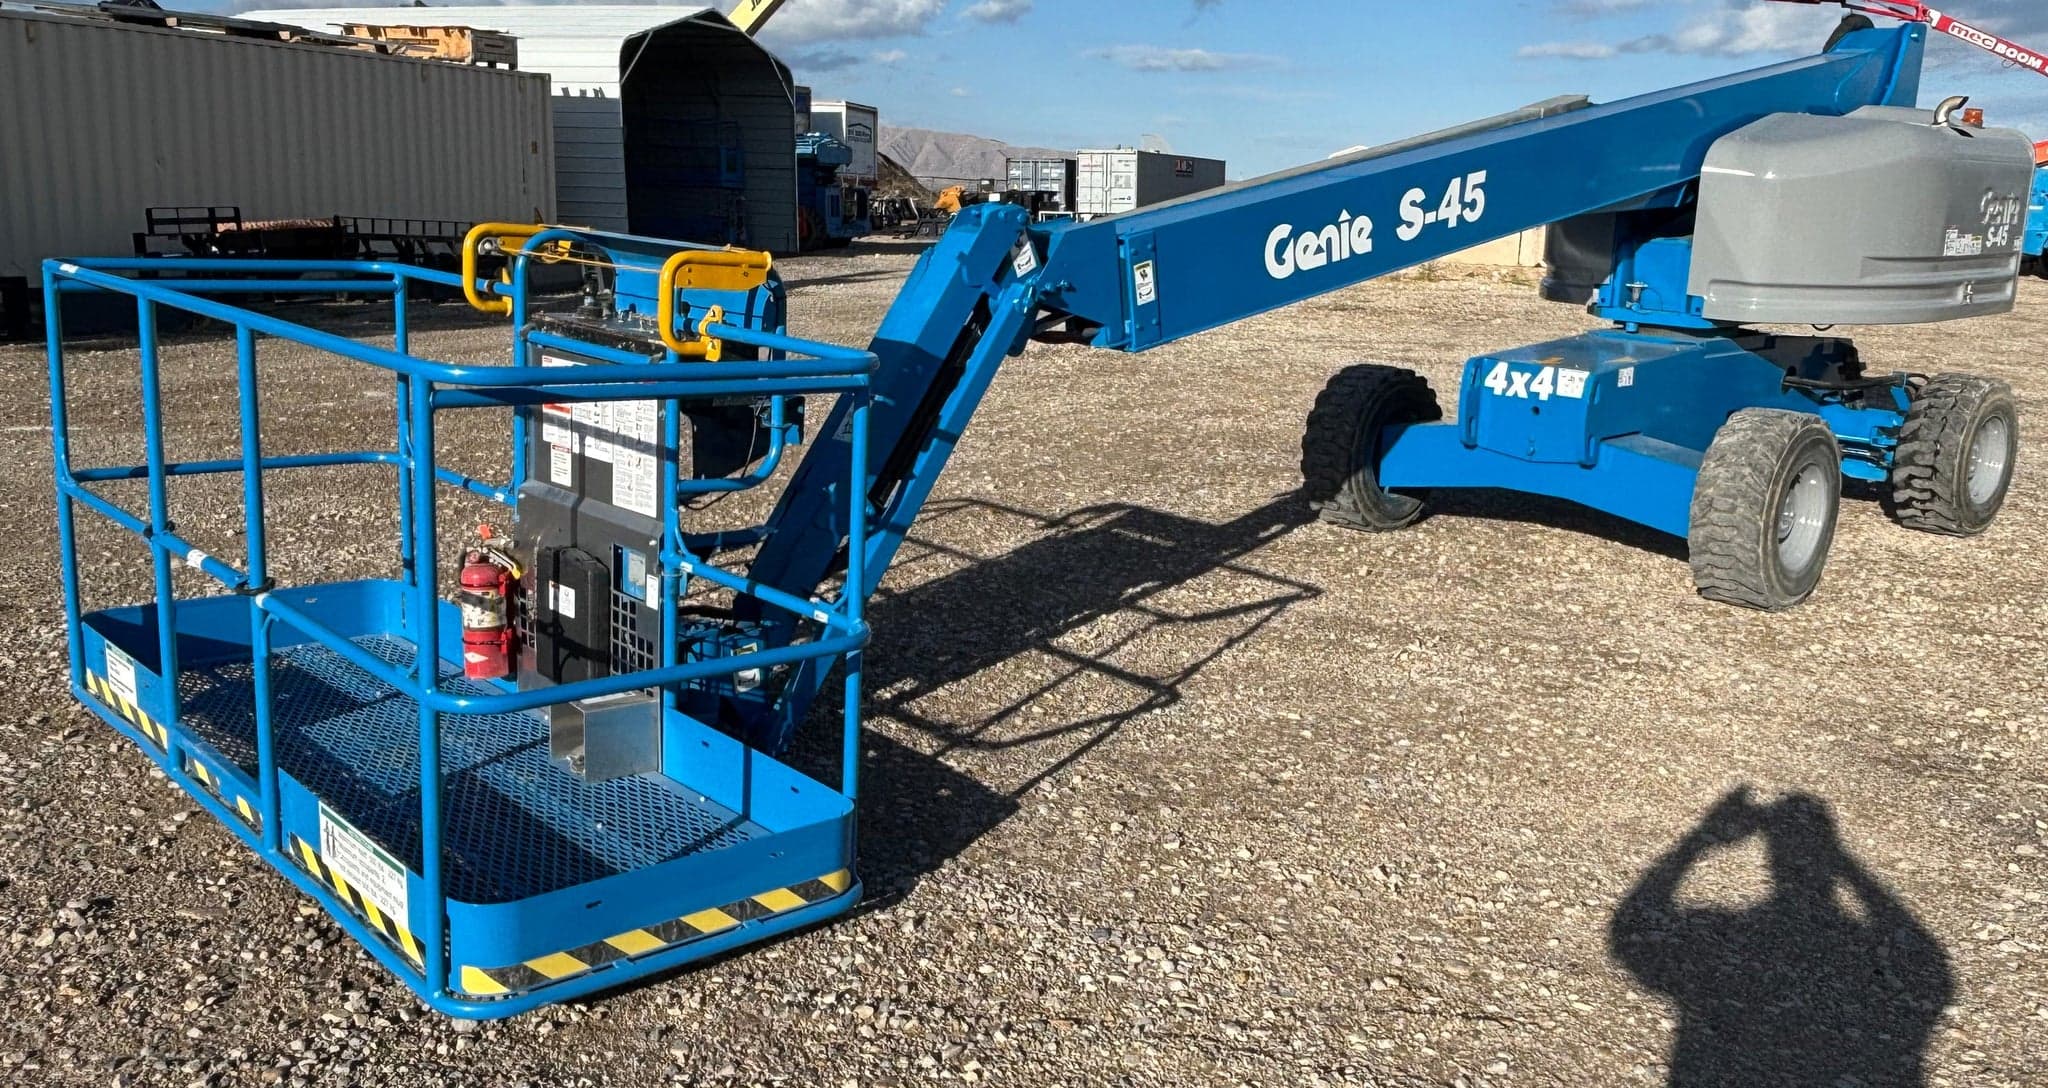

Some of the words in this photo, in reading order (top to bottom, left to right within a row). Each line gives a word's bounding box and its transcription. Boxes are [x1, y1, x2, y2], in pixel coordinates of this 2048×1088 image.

[1950, 25, 1994, 47] mec
[1993, 42, 2043, 69] BOOM
[1264, 208, 1373, 280] Genie
[1396, 169, 1487, 242] S-45
[1985, 224, 2009, 248] S-45
[1484, 361, 1554, 401] 4x4
